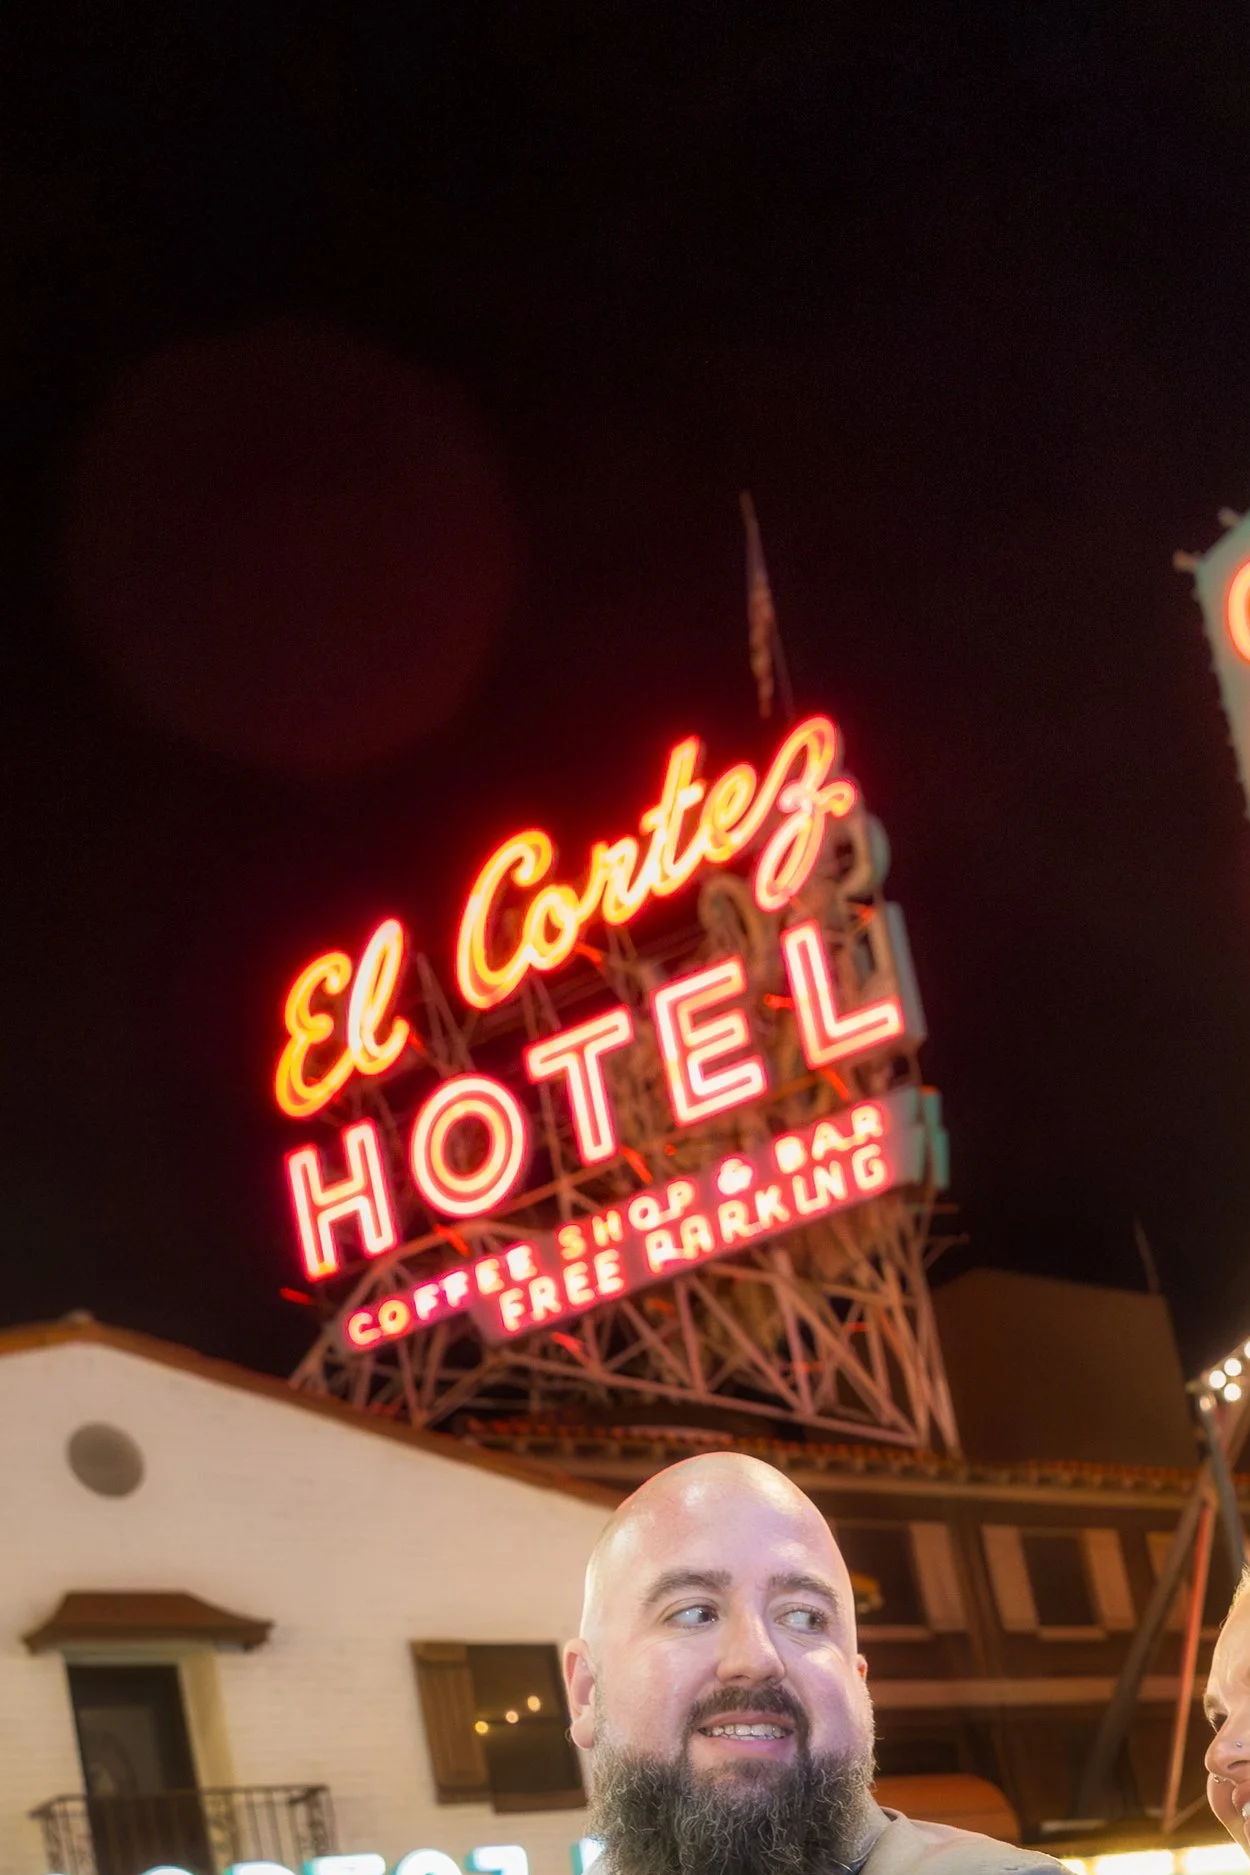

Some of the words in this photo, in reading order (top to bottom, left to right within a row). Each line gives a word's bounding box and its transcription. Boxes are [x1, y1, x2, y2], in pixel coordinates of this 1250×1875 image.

[273, 918, 410, 1118] El
[456, 714, 856, 1012] Cortez
[285, 923, 904, 1279] HOTEL
[345, 1243, 540, 1347] COFFEE
[558, 1180, 695, 1260] SHOP
[716, 1157, 752, 1196] &
[775, 1103, 884, 1174] BAR
[500, 1248, 624, 1336] FREE
[648, 1144, 889, 1273] PARKING
